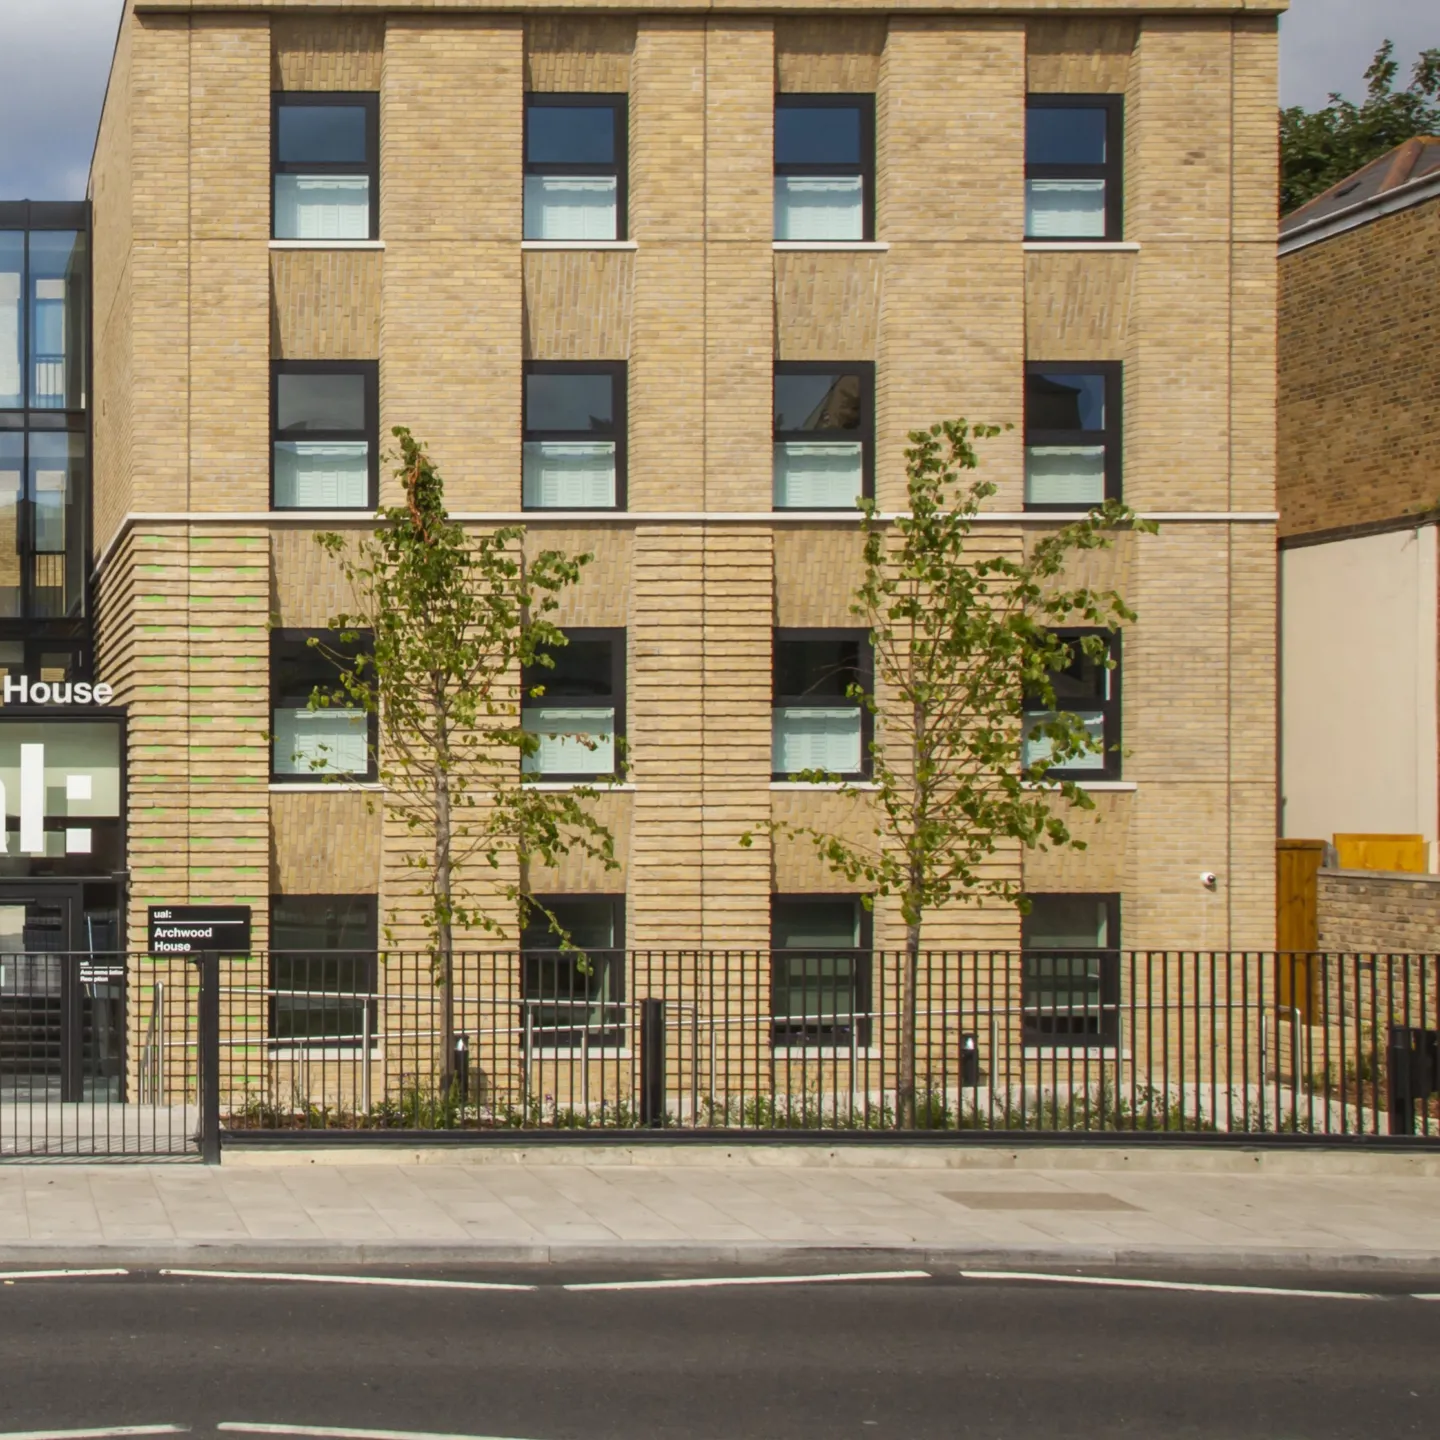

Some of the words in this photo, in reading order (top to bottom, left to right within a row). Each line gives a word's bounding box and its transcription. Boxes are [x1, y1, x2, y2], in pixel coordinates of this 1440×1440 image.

[4, 675, 112, 703] House
[153, 909, 172, 919] ual:
[153, 926, 213, 938] Archwood
[154, 940, 191, 952] House
